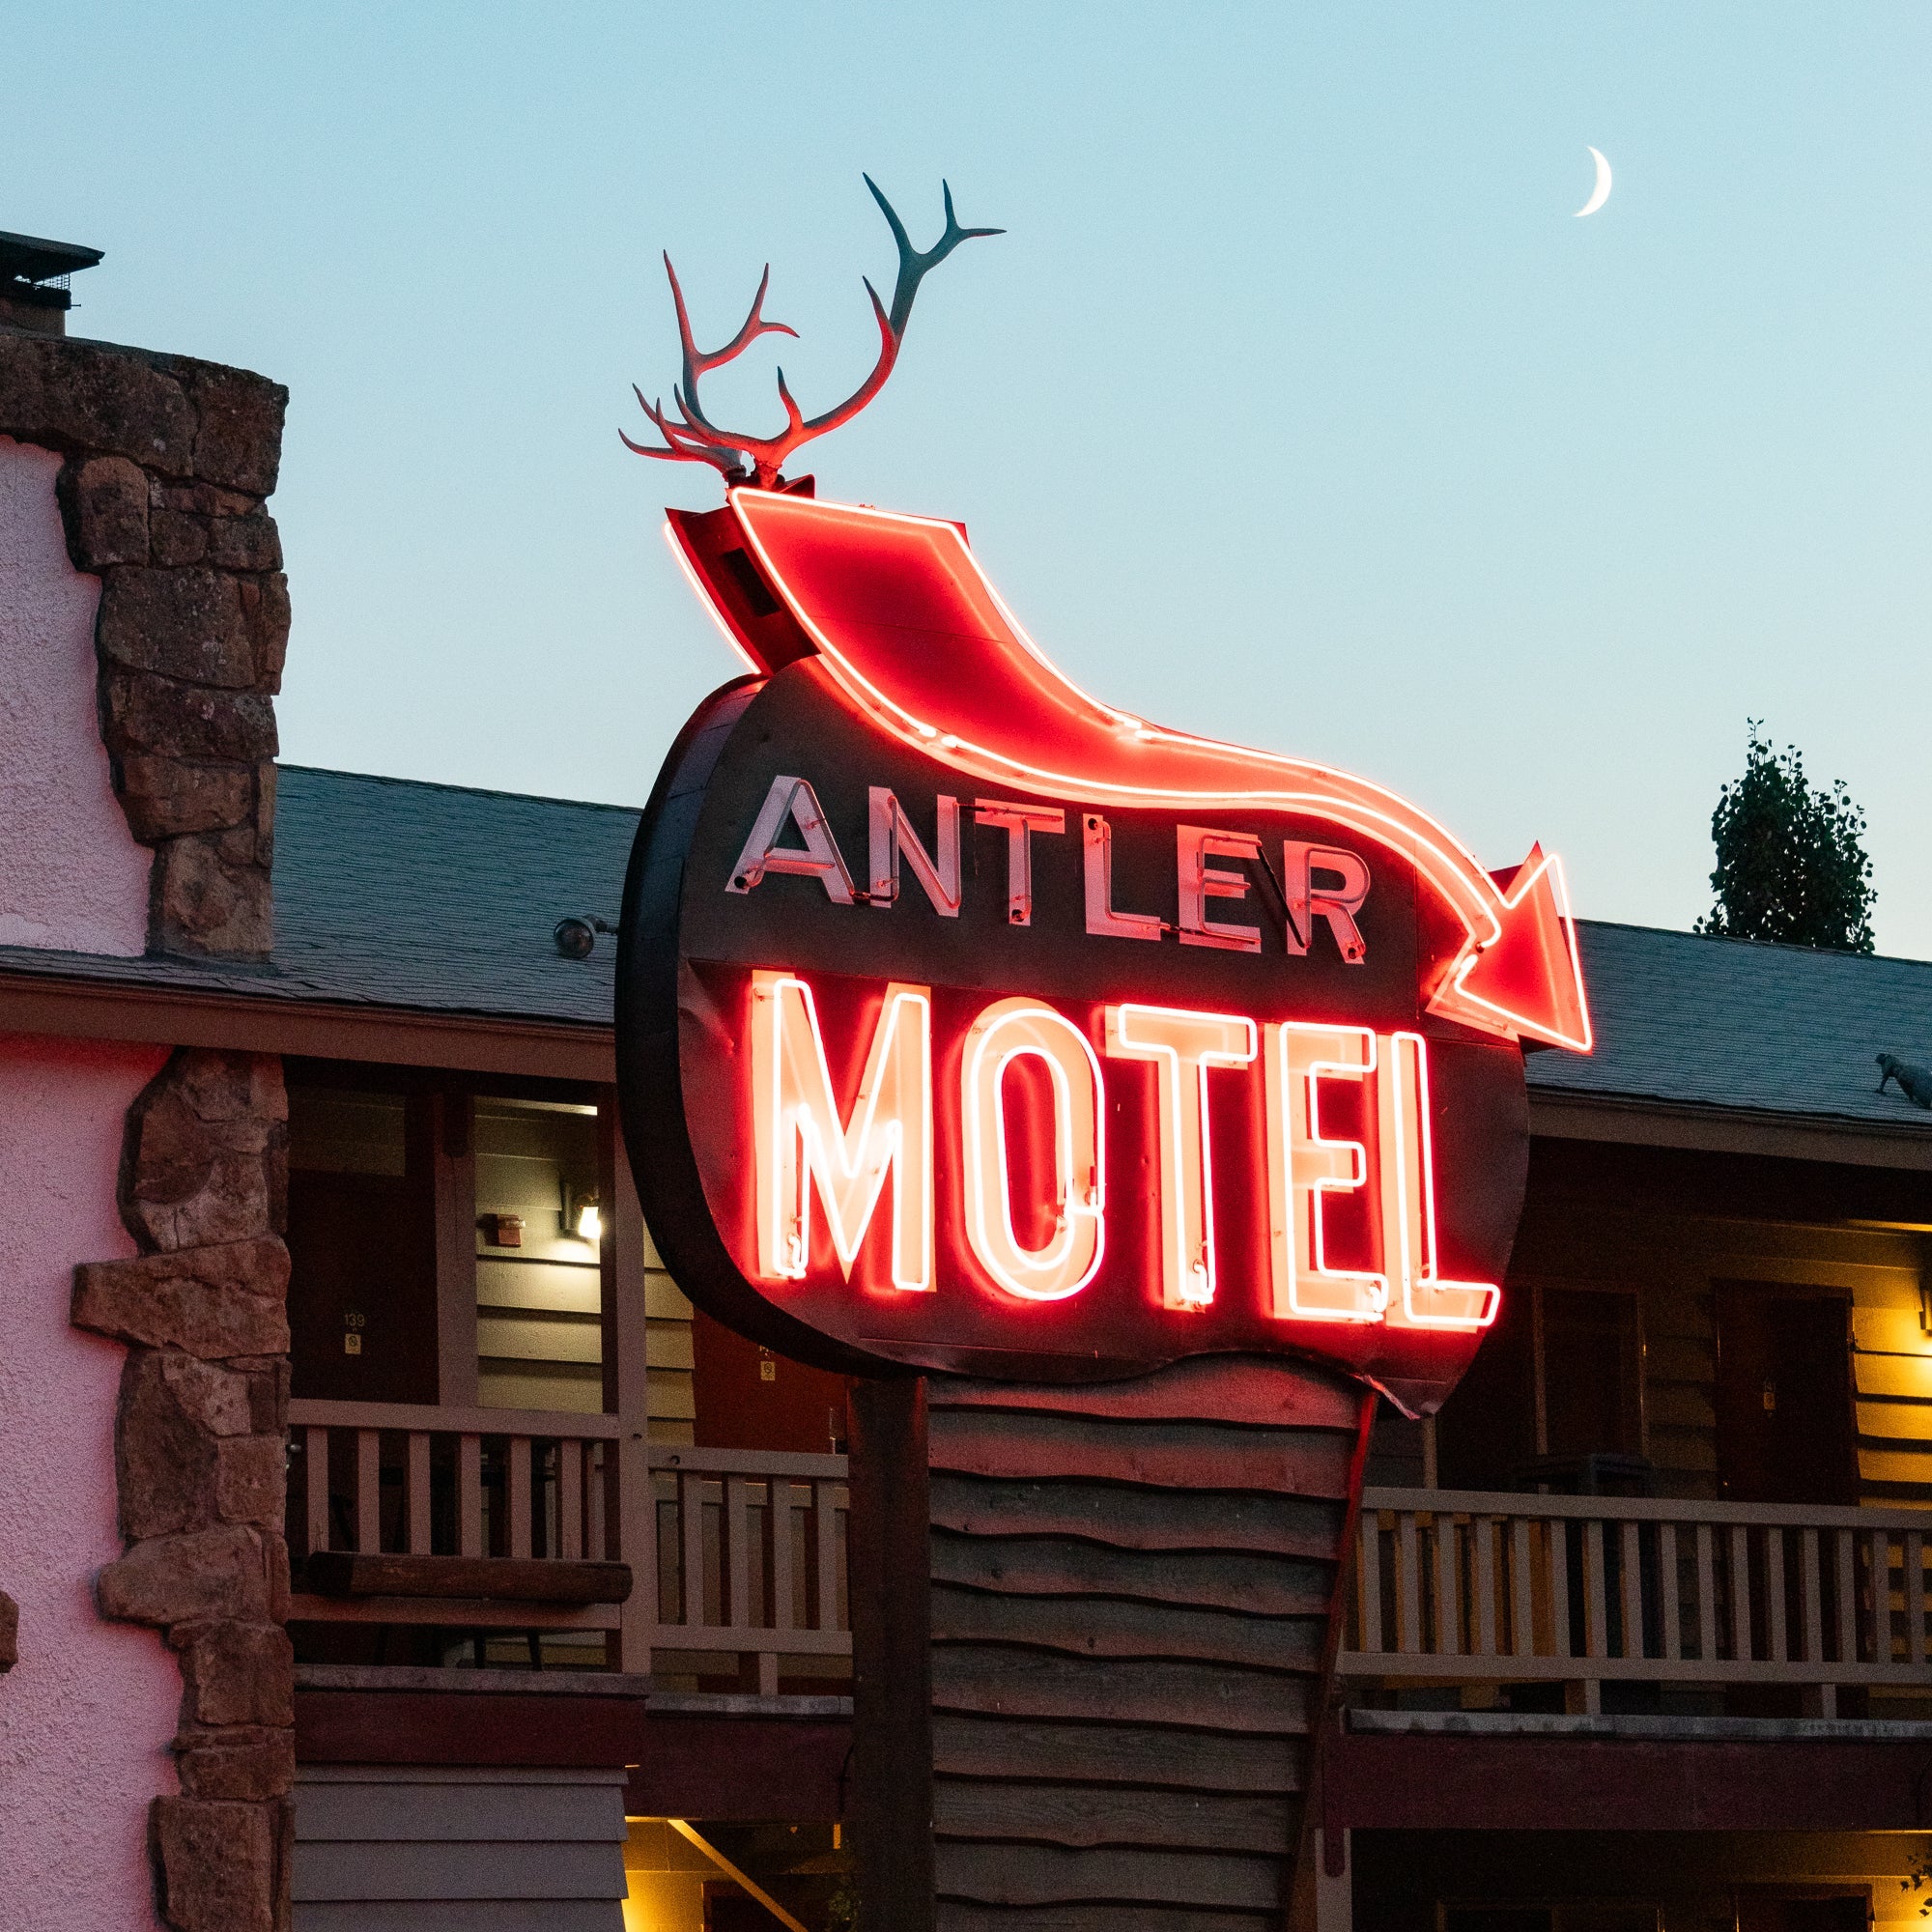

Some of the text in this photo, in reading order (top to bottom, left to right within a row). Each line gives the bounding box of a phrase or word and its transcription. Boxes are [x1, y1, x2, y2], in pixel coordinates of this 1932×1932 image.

[724, 775, 1370, 964] ANTLER
[752, 970, 1500, 1333] MOTEL
[345, 1313, 365, 1327] 139
